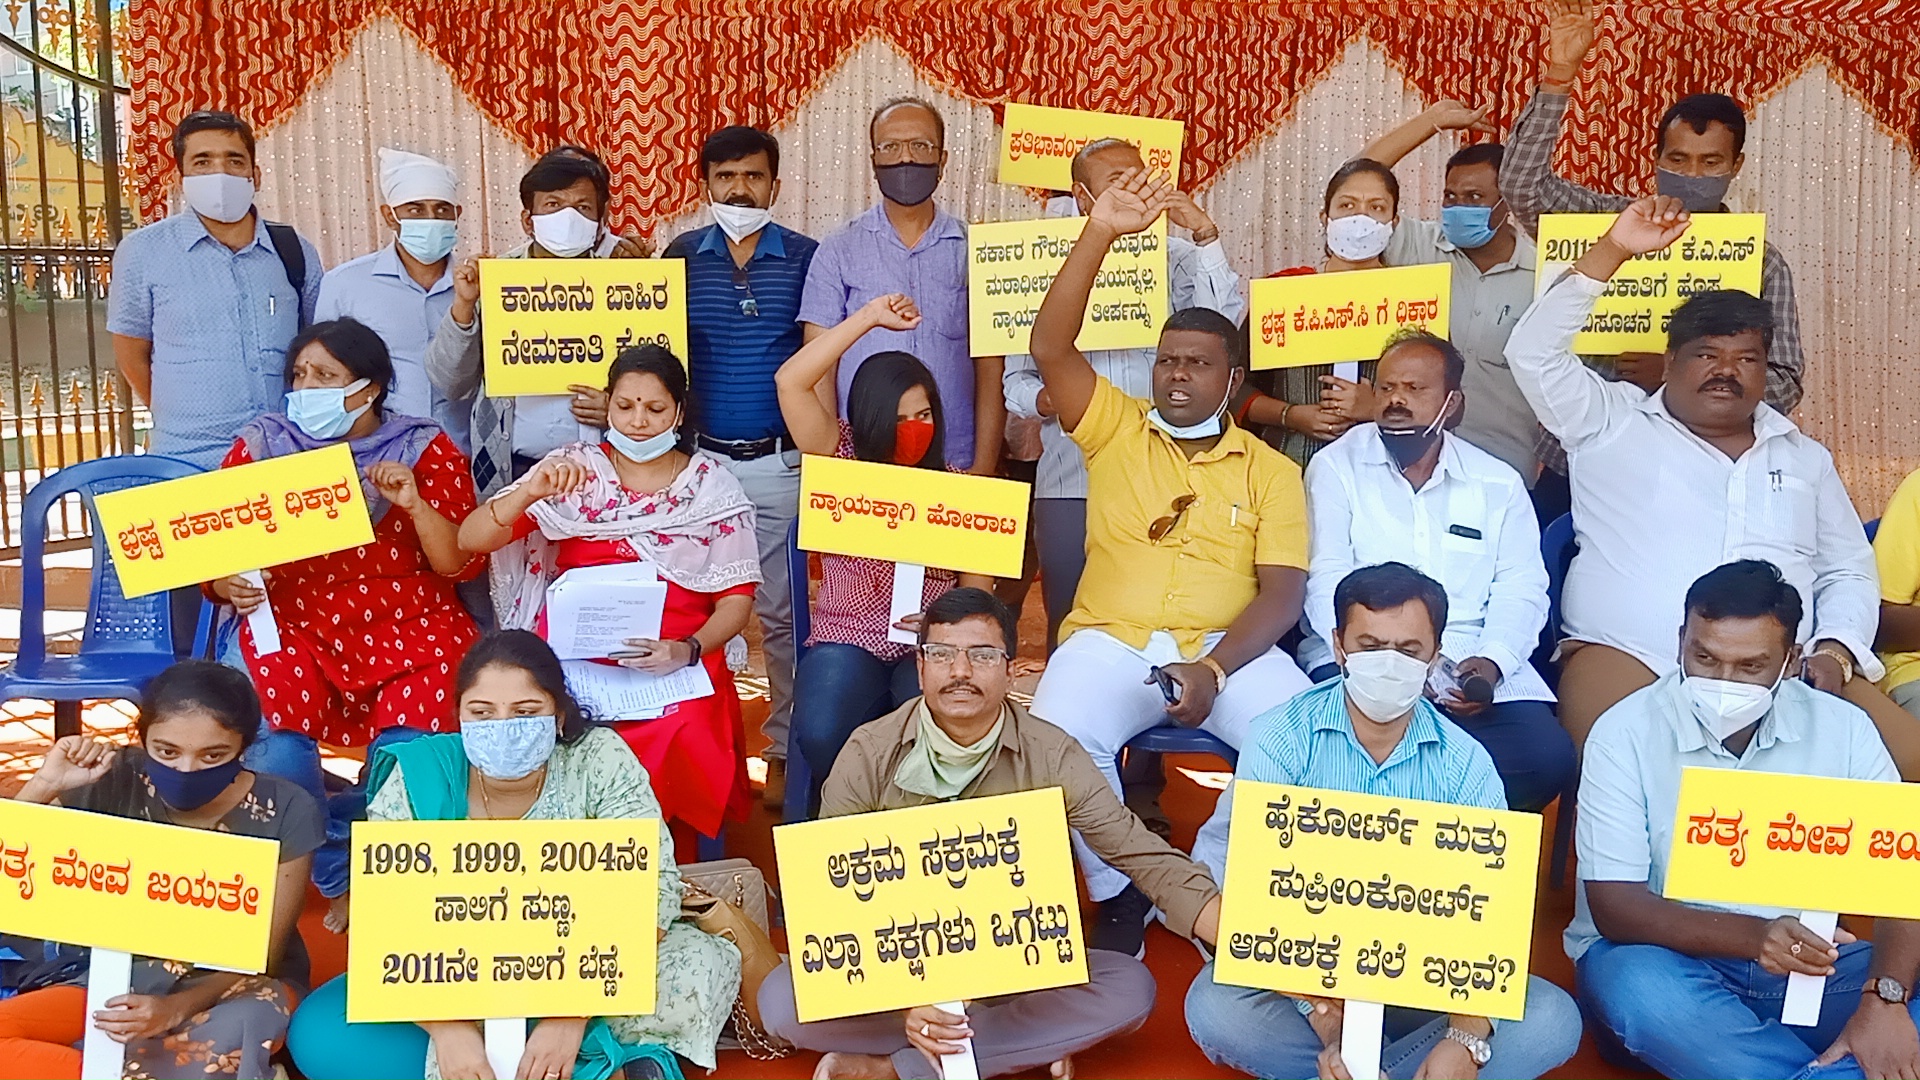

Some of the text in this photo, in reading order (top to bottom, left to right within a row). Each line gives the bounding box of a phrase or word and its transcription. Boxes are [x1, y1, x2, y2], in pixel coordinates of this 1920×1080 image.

[975, 240, 1025, 264] ಸರ್ಕಾರ
[1679, 234, 1756, 262] ಕೆ.ಎ.ಎಸ್
[500, 277, 669, 313] ಕಾನೂನು ಬಾಹಿರ
[1091, 299, 1152, 329] ತೀರ್ಪನ್ನು
[1261, 292, 1441, 348] ಭ್ರಷ್ಟ ಕೆ.ಪಿ.ಎಸ್.ಸಿ ಗೆ ಧಿಕ್ಕಾರ
[501, 329, 605, 366] ನೇಮಕಾತಿ
[118, 476, 352, 561] ಭ್ರಷ್ಟ ಸರ್ಕಾರಕ್ಕೆ ಧಿಕ್ಕಾರ
[809, 492, 1017, 536] ನ್ಯಾಯಕ್ಕಾಗಿ ಹೋರಾಟ
[362, 837, 649, 877] 1998, 1999, 2004ನೇ
[1264, 794, 1507, 870] ಹೈಕೋರ್ಟ್ ಮತ್ತು
[1686, 807, 1749, 868] ಸತ್ಯ
[1766, 812, 1854, 856] ಮೇವ
[51, 848, 131, 896] ಮೇವ
[146, 871, 259, 916] ಜಯತೇ
[827, 816, 1025, 903] ಅಕ್ರಮ ಸಕ್ರಮಕ್ಕೆ
[434, 886, 577, 938] ಸಾಲಿಗೆ ಸುಣ್ಣ,
[1269, 862, 1490, 922] ಸುಪ್ರೀಂಕೋರ್ಟ್
[801, 896, 1074, 985] ಎಲ್ಲಾ ಪಕ್ಷಗಳು ಒಗ್ಗಟ್ಟು
[1229, 926, 1516, 1001] ಆದೇಶಕ್ಕೆ ಬೆಲೆ ಇಲ್ಲವೆ?
[382, 944, 624, 997] 2011ನೇ ಸಾಲಿಗೆ ಬೆಣ್ಣೆ.
